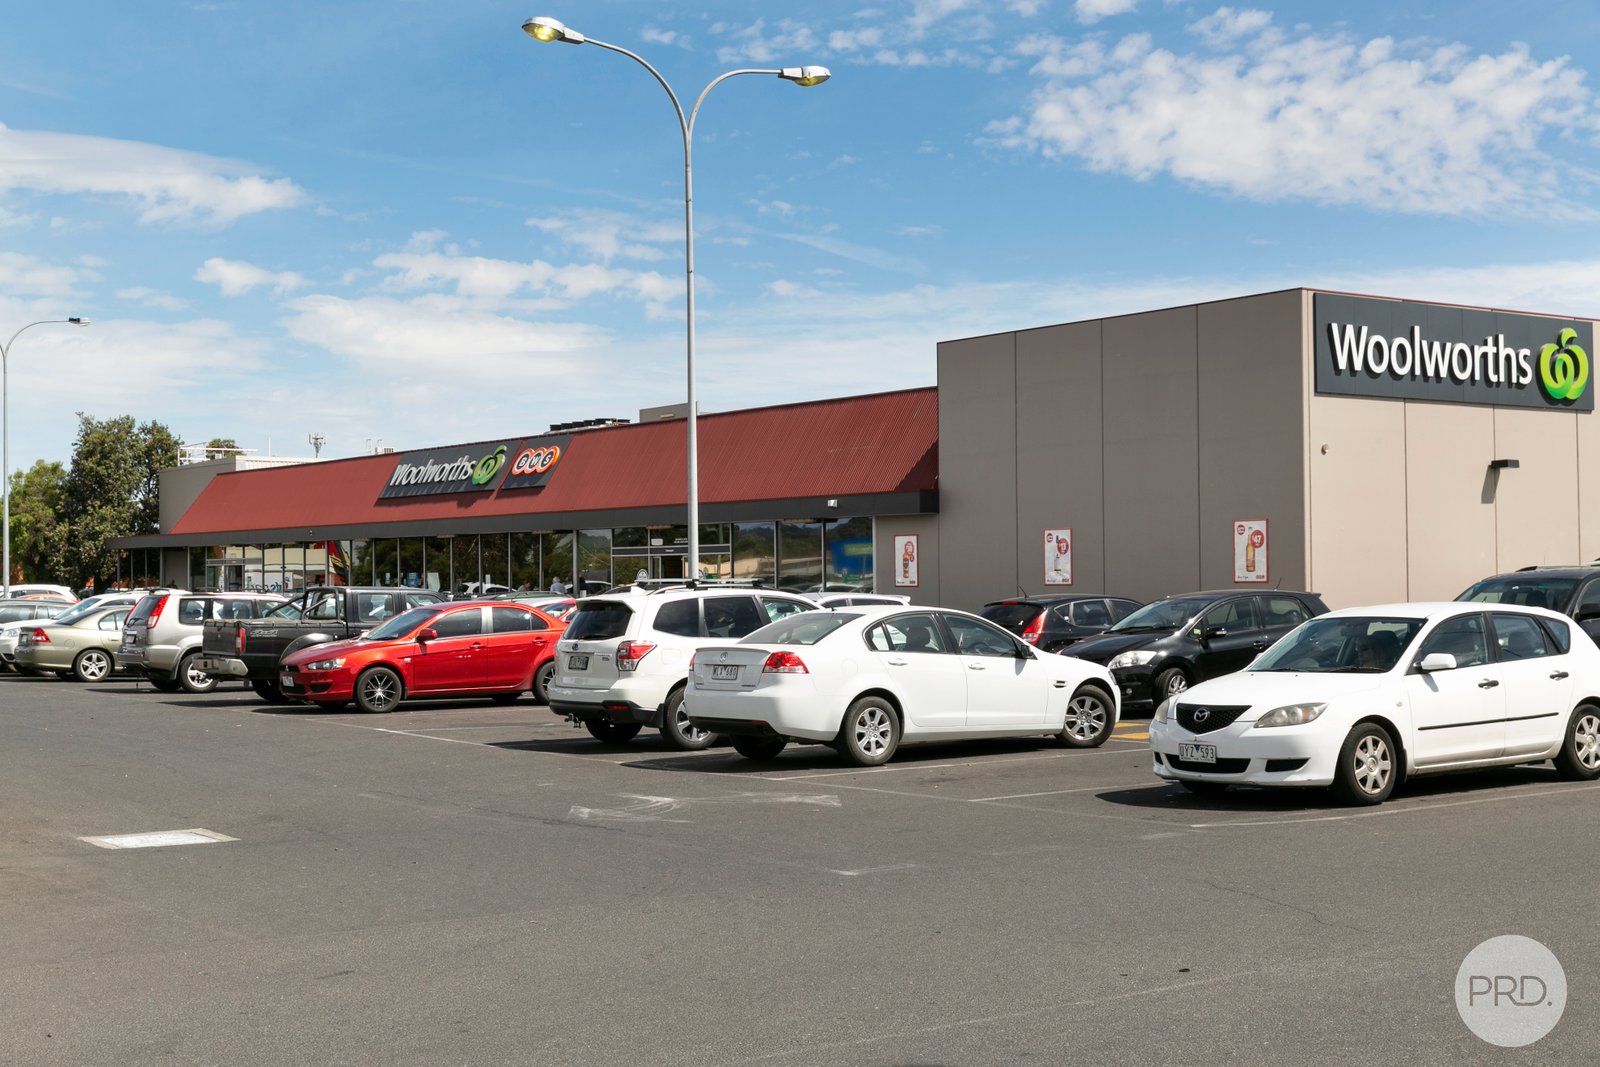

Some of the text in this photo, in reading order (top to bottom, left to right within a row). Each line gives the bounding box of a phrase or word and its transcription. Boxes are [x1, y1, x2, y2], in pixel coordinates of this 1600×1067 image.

[1330, 322, 1532, 385] Woolworths
[389, 455, 477, 487] Woolworths
[515, 449, 555, 470] BWS
[1200, 747, 1214, 759] 593
